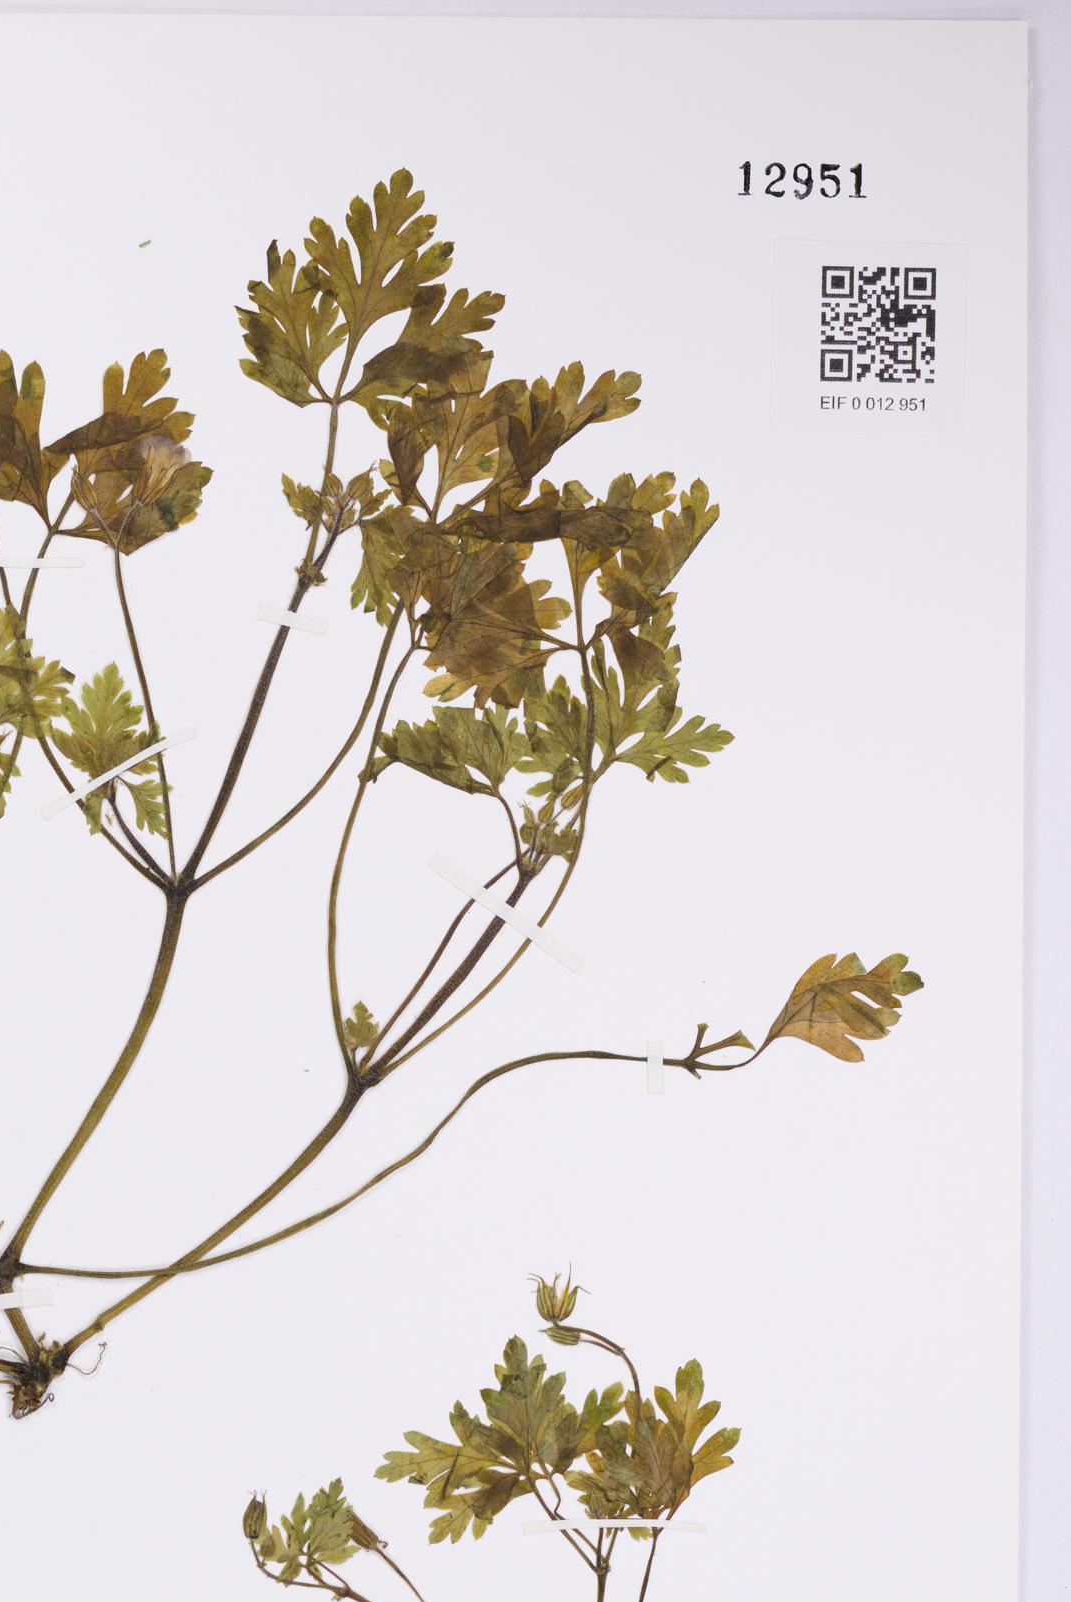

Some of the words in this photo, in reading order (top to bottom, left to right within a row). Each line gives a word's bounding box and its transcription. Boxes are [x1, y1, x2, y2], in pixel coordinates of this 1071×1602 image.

[737, 160, 868, 201] 12951
[820, 395, 847, 410] EIF
[851, 396, 862, 410] 0
[865, 396, 895, 411] 012
[899, 397, 926, 412] 951
